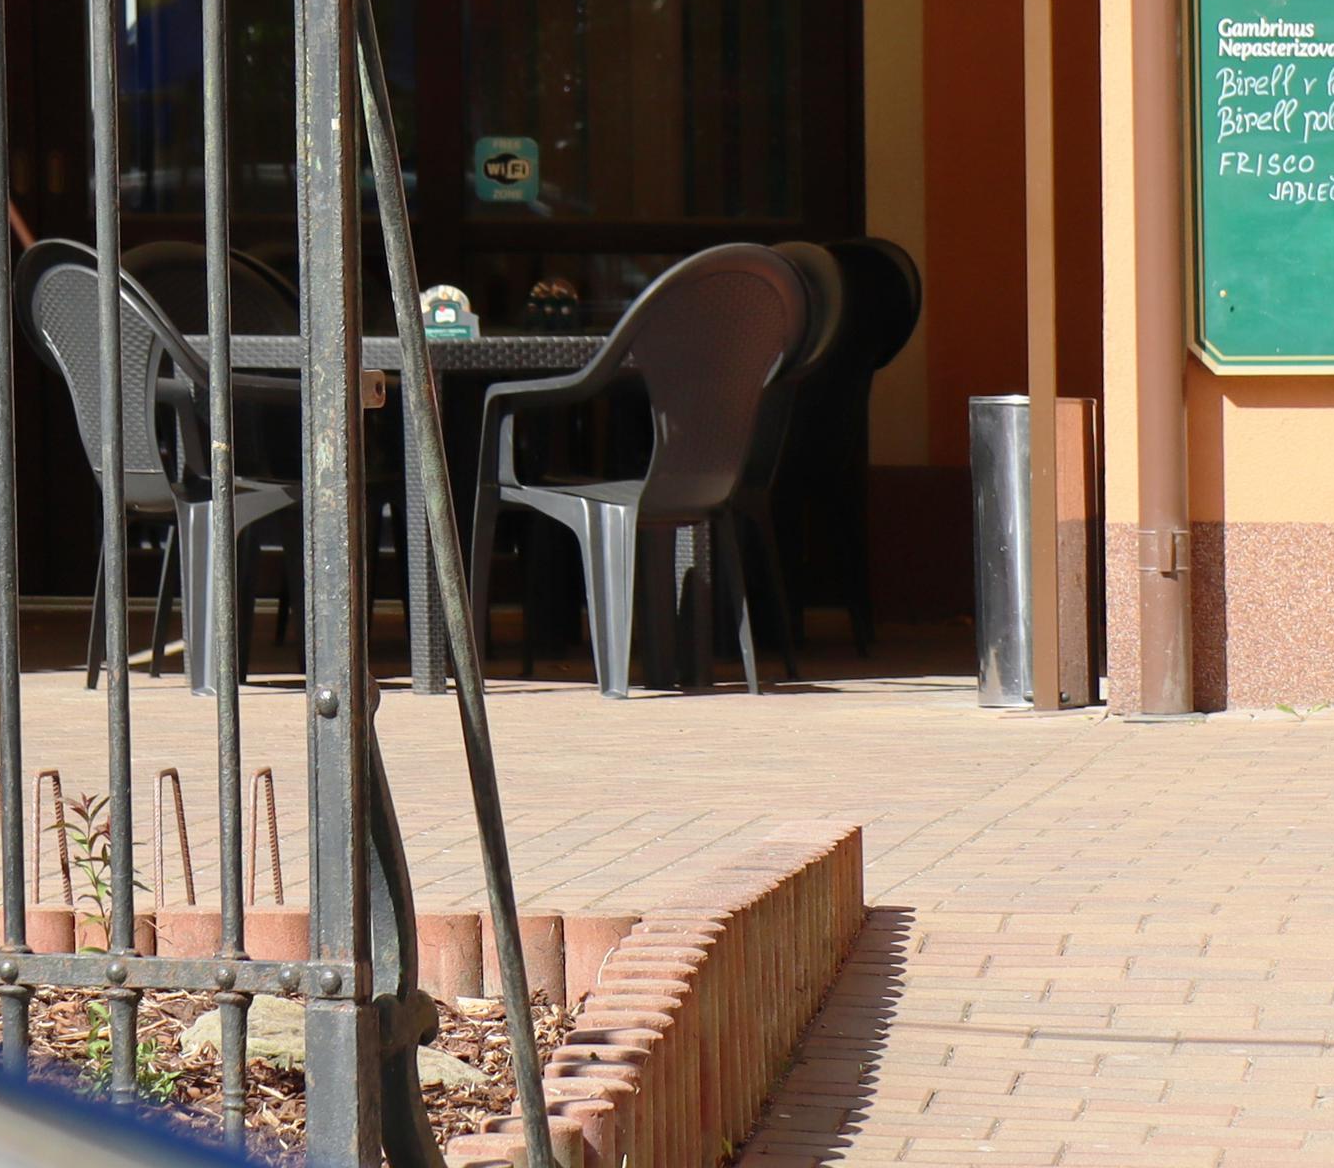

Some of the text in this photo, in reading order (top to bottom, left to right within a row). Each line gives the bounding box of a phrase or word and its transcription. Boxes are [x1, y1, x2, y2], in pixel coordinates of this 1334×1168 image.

[1217, 17, 1315, 39] Gambrinus
[1216, 63, 1296, 105] Birell
[1217, 98, 1298, 143] Birell
[1219, 151, 1315, 177] FRISCO
